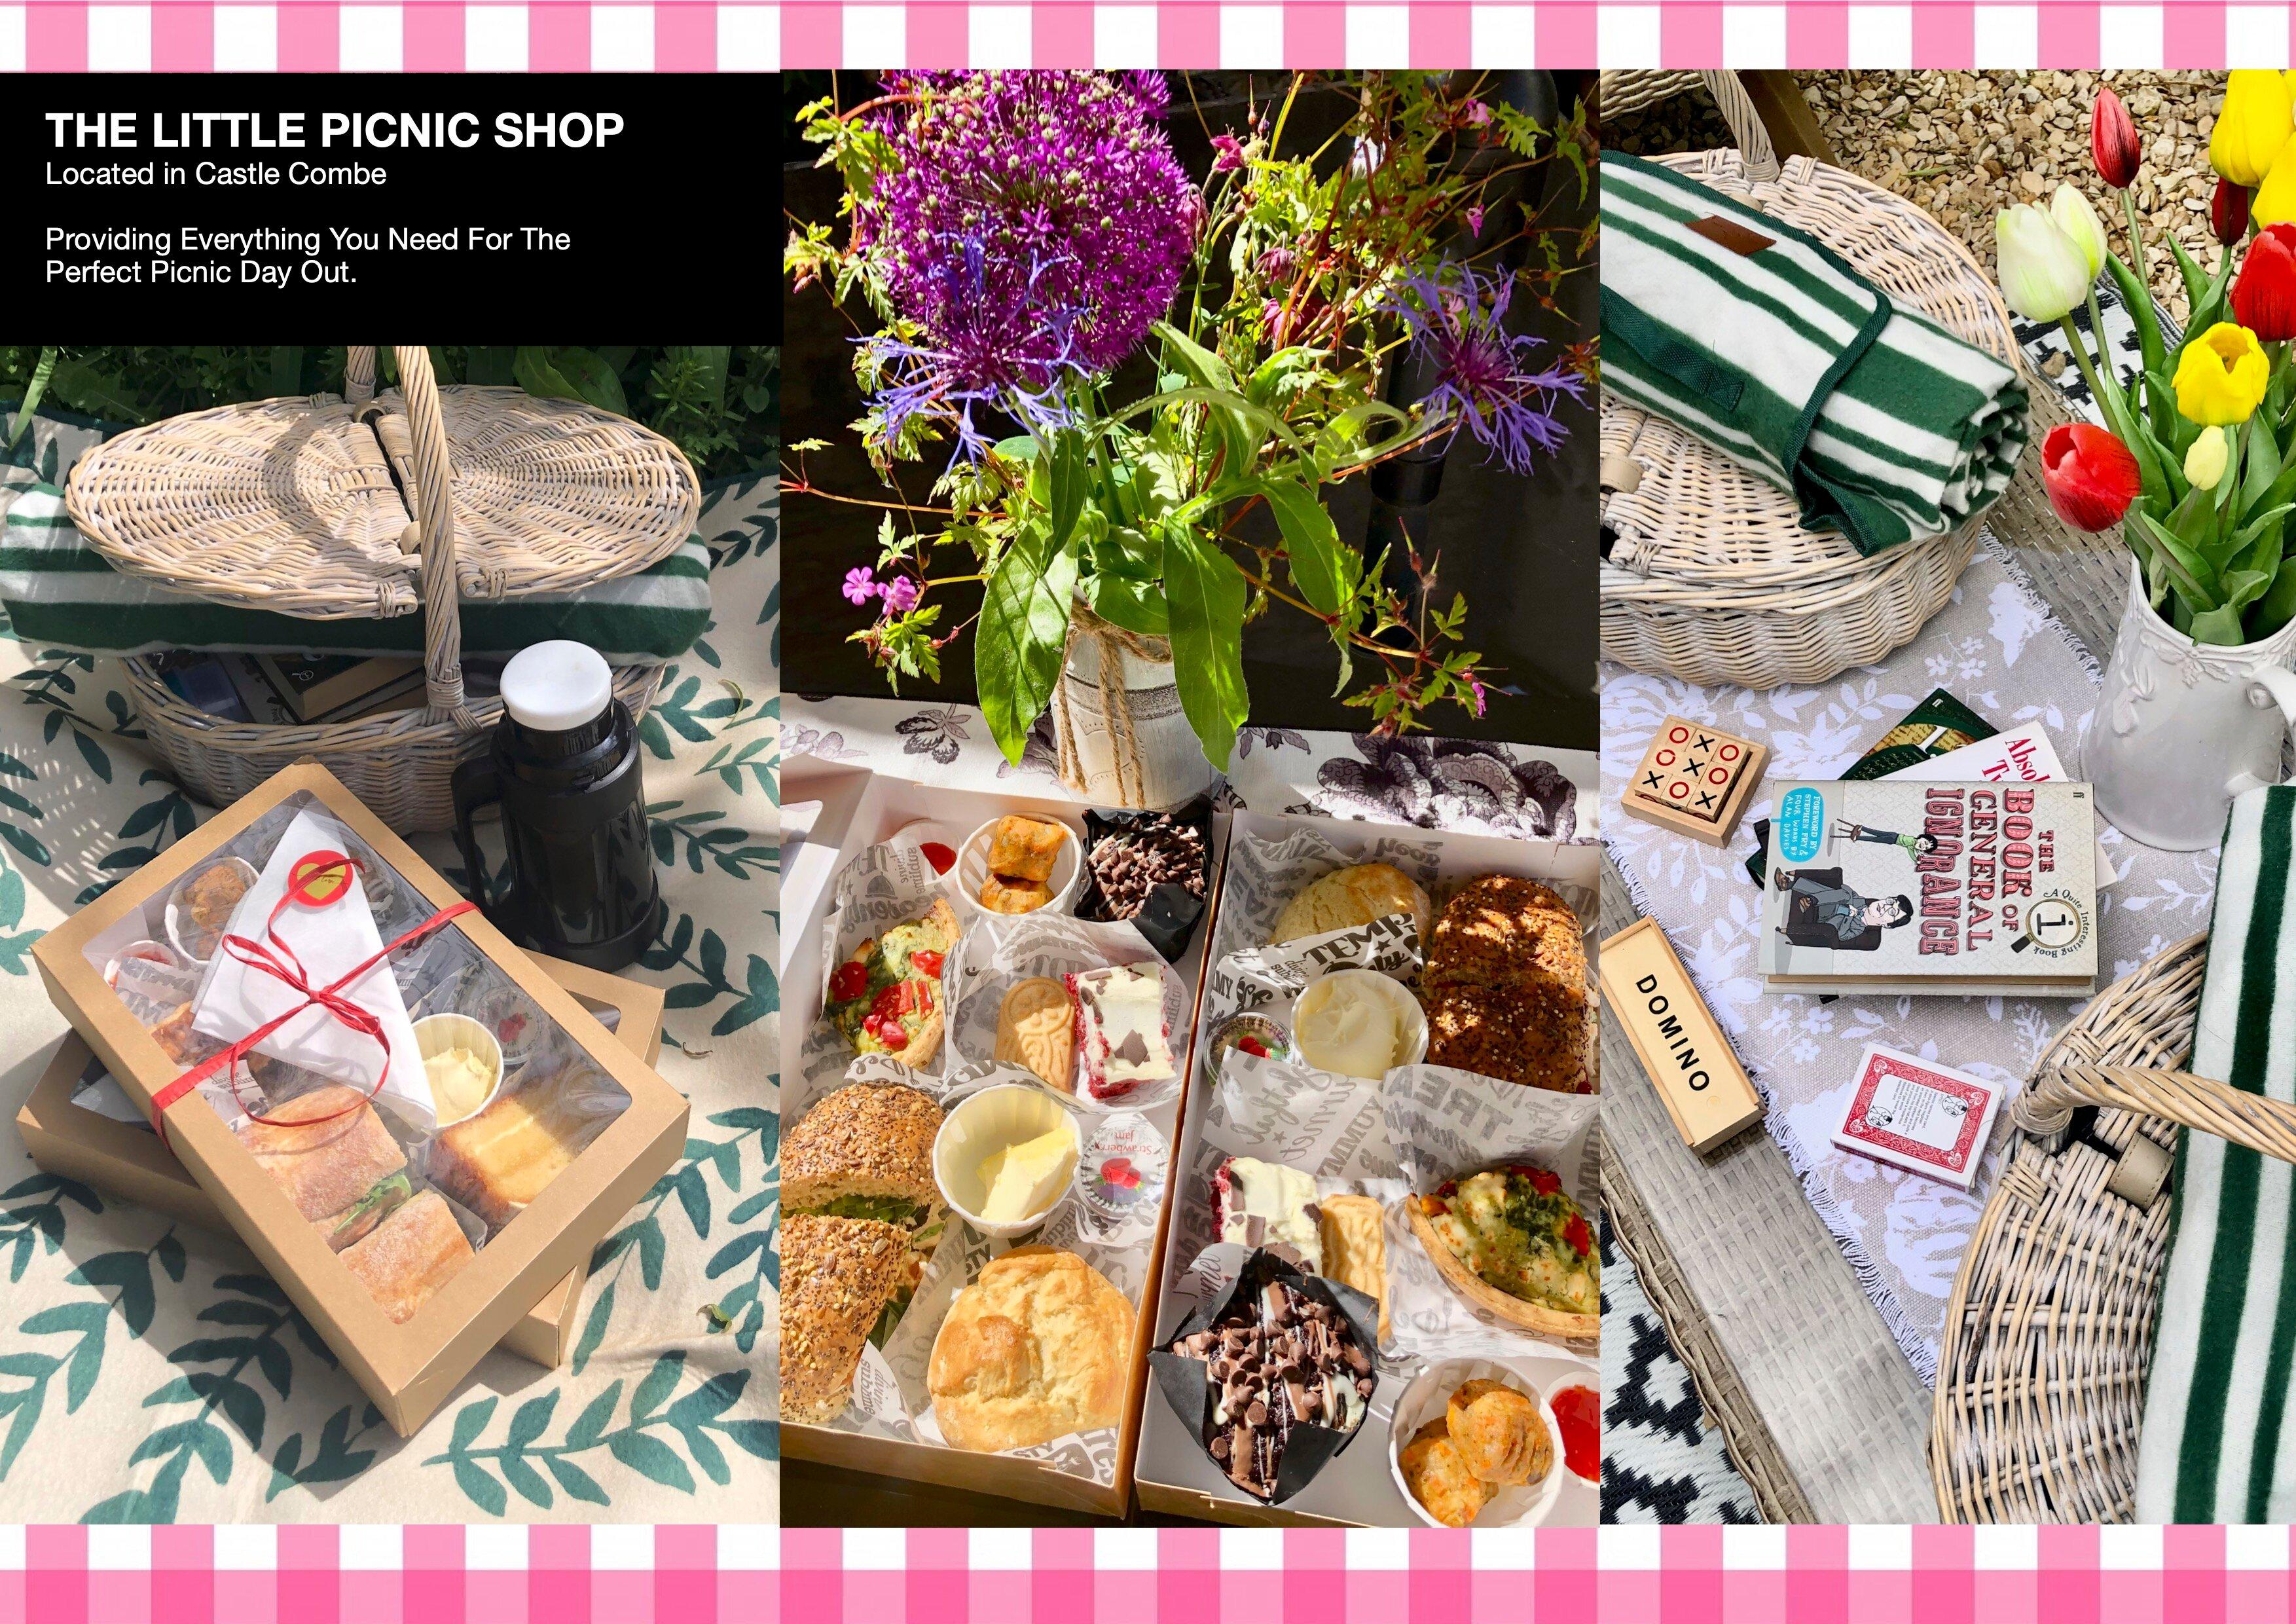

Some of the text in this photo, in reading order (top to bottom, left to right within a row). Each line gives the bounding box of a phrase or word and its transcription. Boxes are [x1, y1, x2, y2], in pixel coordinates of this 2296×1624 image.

[1784, 796, 1794, 818] ALAN
[1791, 794, 1802, 856] FOUR WORDS BY
[1802, 794, 1812, 830] STEPHEN
[1810, 796, 1821, 850] FOREWORD BY
[1915, 787, 1965, 956] IGNORANCE
[1966, 790, 1997, 952] GENERAL
[2001, 787, 2035, 932] BOOK OF
[2038, 830, 2055, 873] THE
[2033, 889, 2090, 957] A Quite Interesting Book
[1635, 973, 1711, 1092] DOMINO
[1094, 1141, 1152, 1155] Strawberry
[1115, 1130, 1135, 1142] Jam
